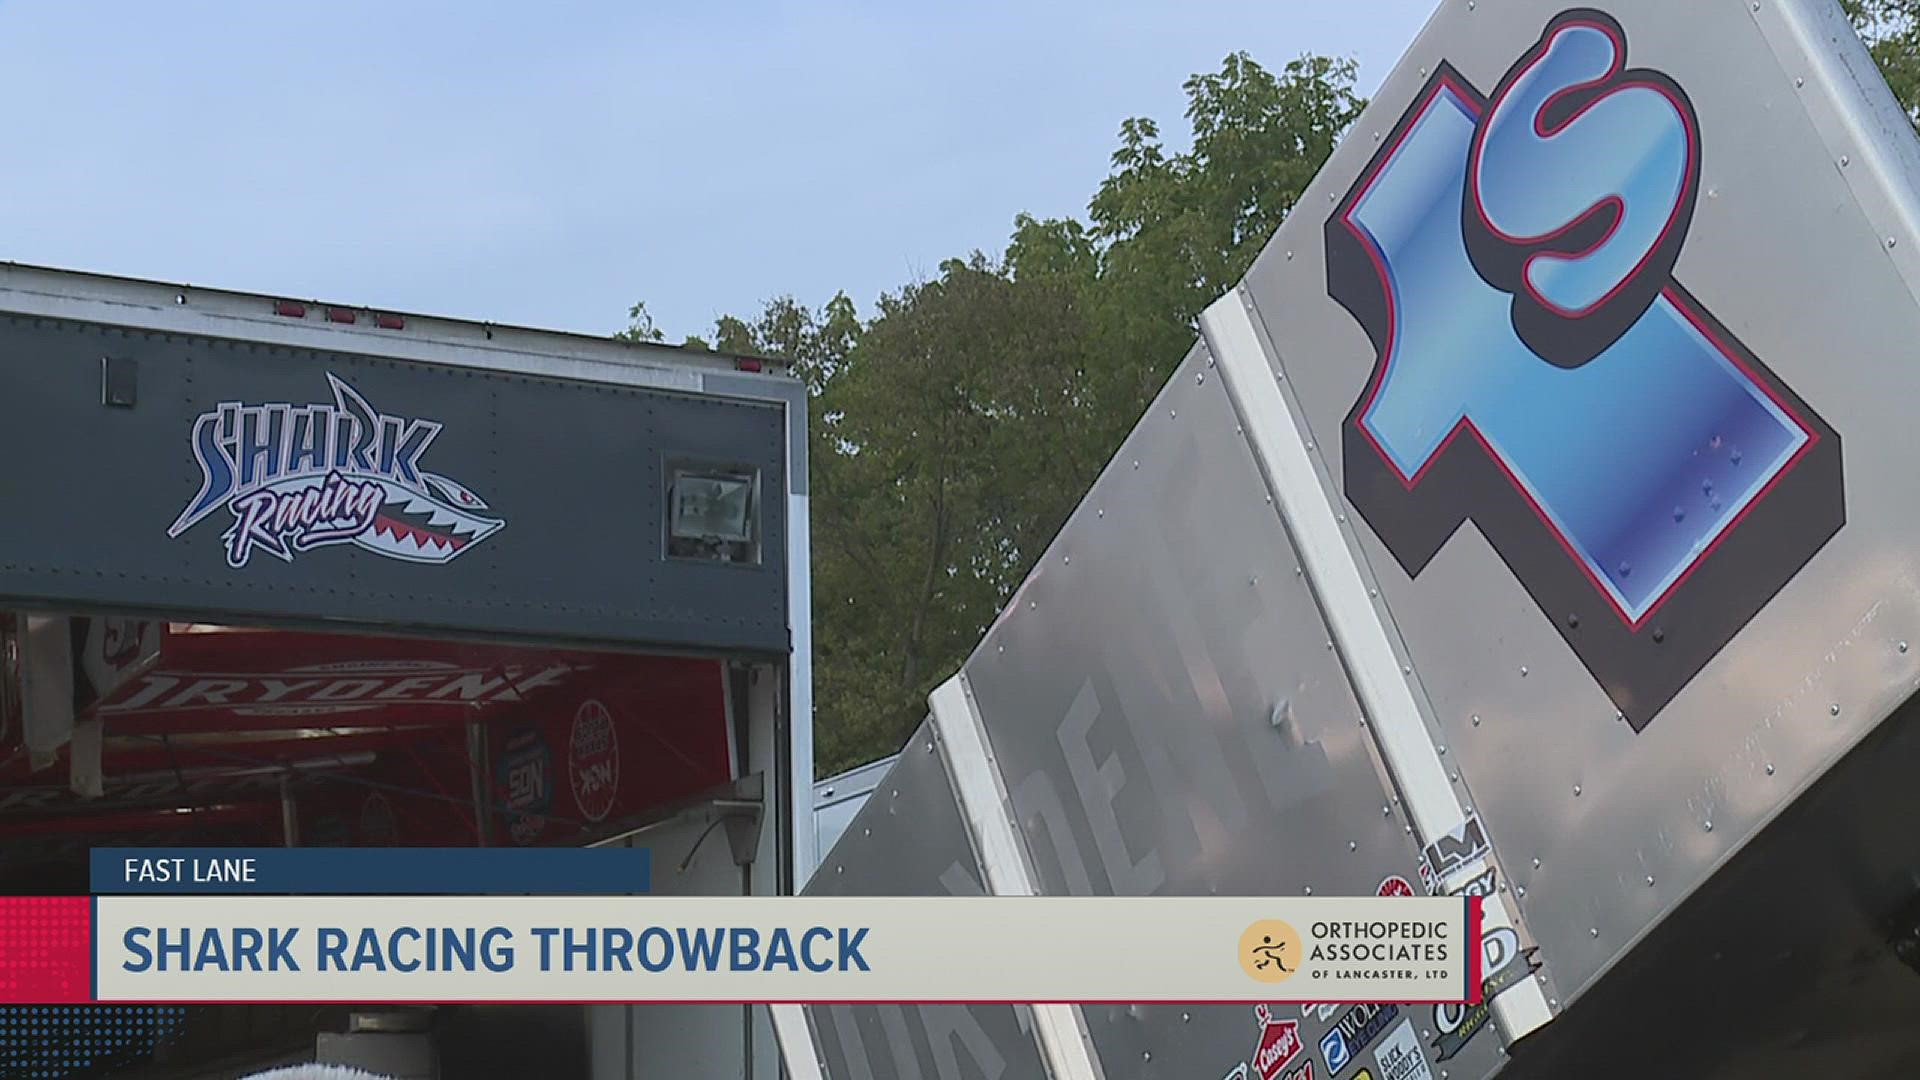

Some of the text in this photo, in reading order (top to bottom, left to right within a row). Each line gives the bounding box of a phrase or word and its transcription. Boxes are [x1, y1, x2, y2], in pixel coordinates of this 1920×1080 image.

[167, 371, 443, 538] SHARK
[228, 470, 386, 561] Racing
[1259, 1025, 1295, 1073] Casey's
